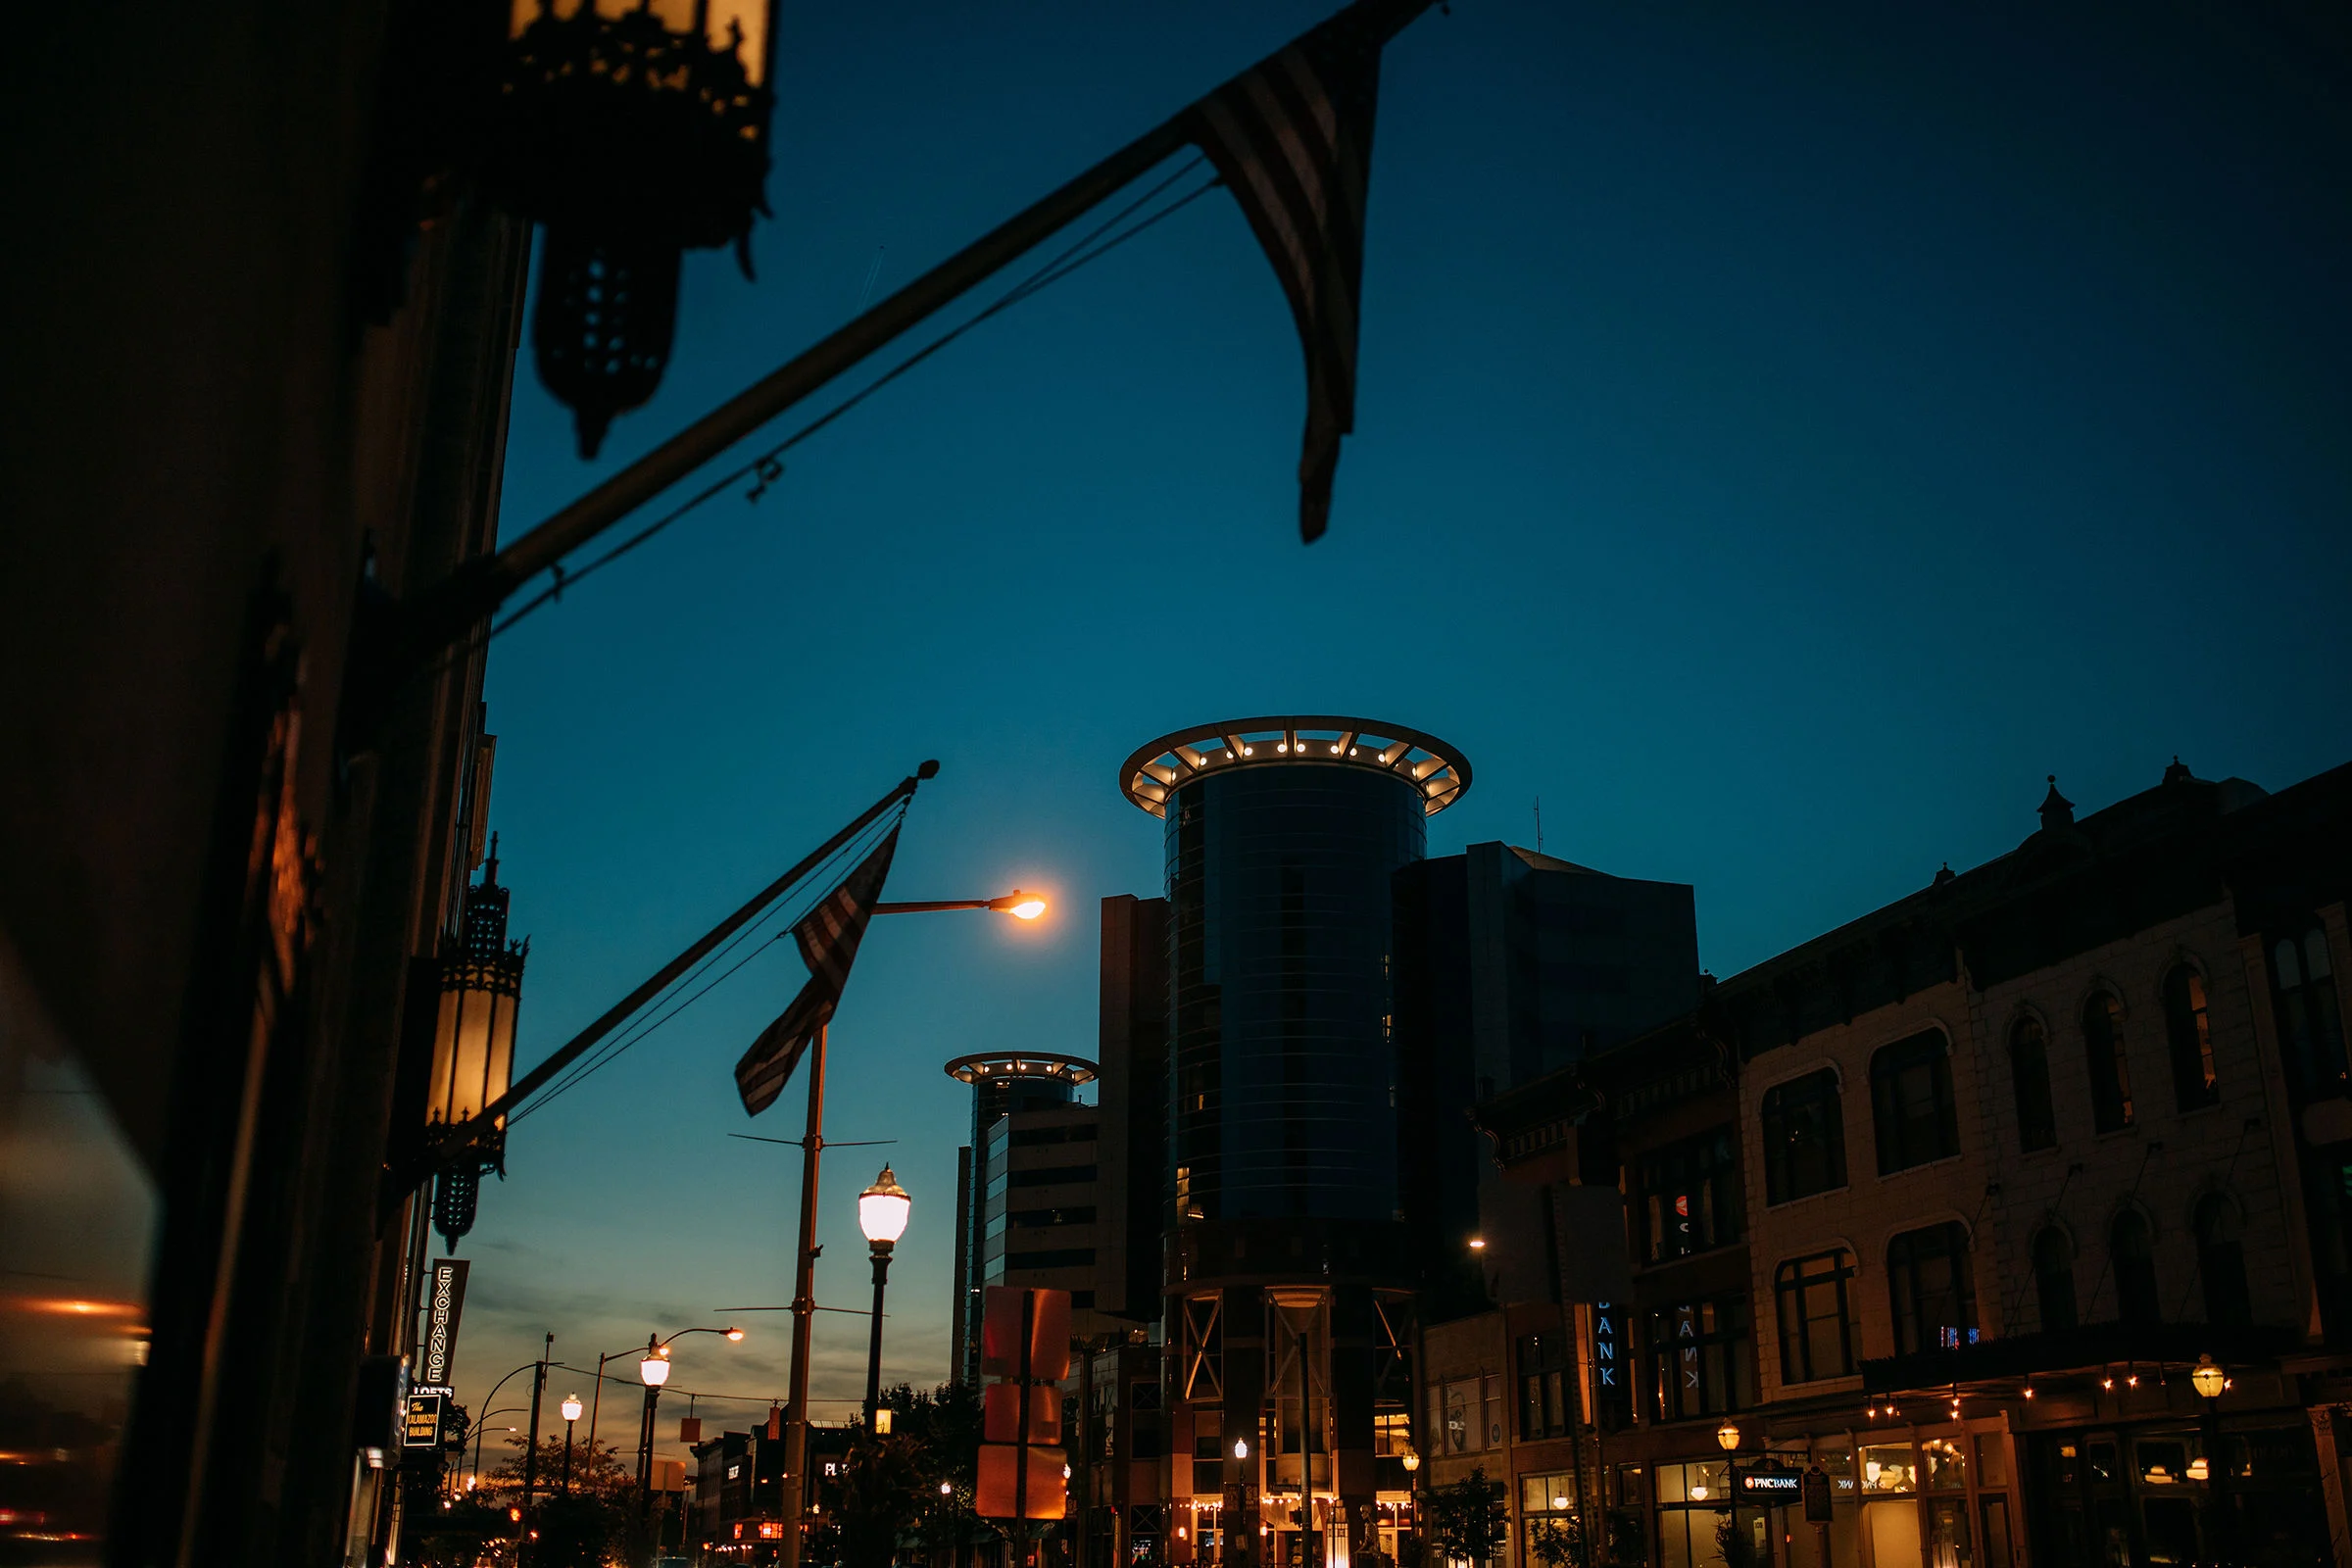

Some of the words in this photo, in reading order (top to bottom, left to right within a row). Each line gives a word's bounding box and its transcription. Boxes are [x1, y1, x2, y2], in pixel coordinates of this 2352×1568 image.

[427, 1266, 454, 1383] EXCHANGE
[411, 1401, 424, 1412] The
[409, 1426, 433, 1438] BUILDING
